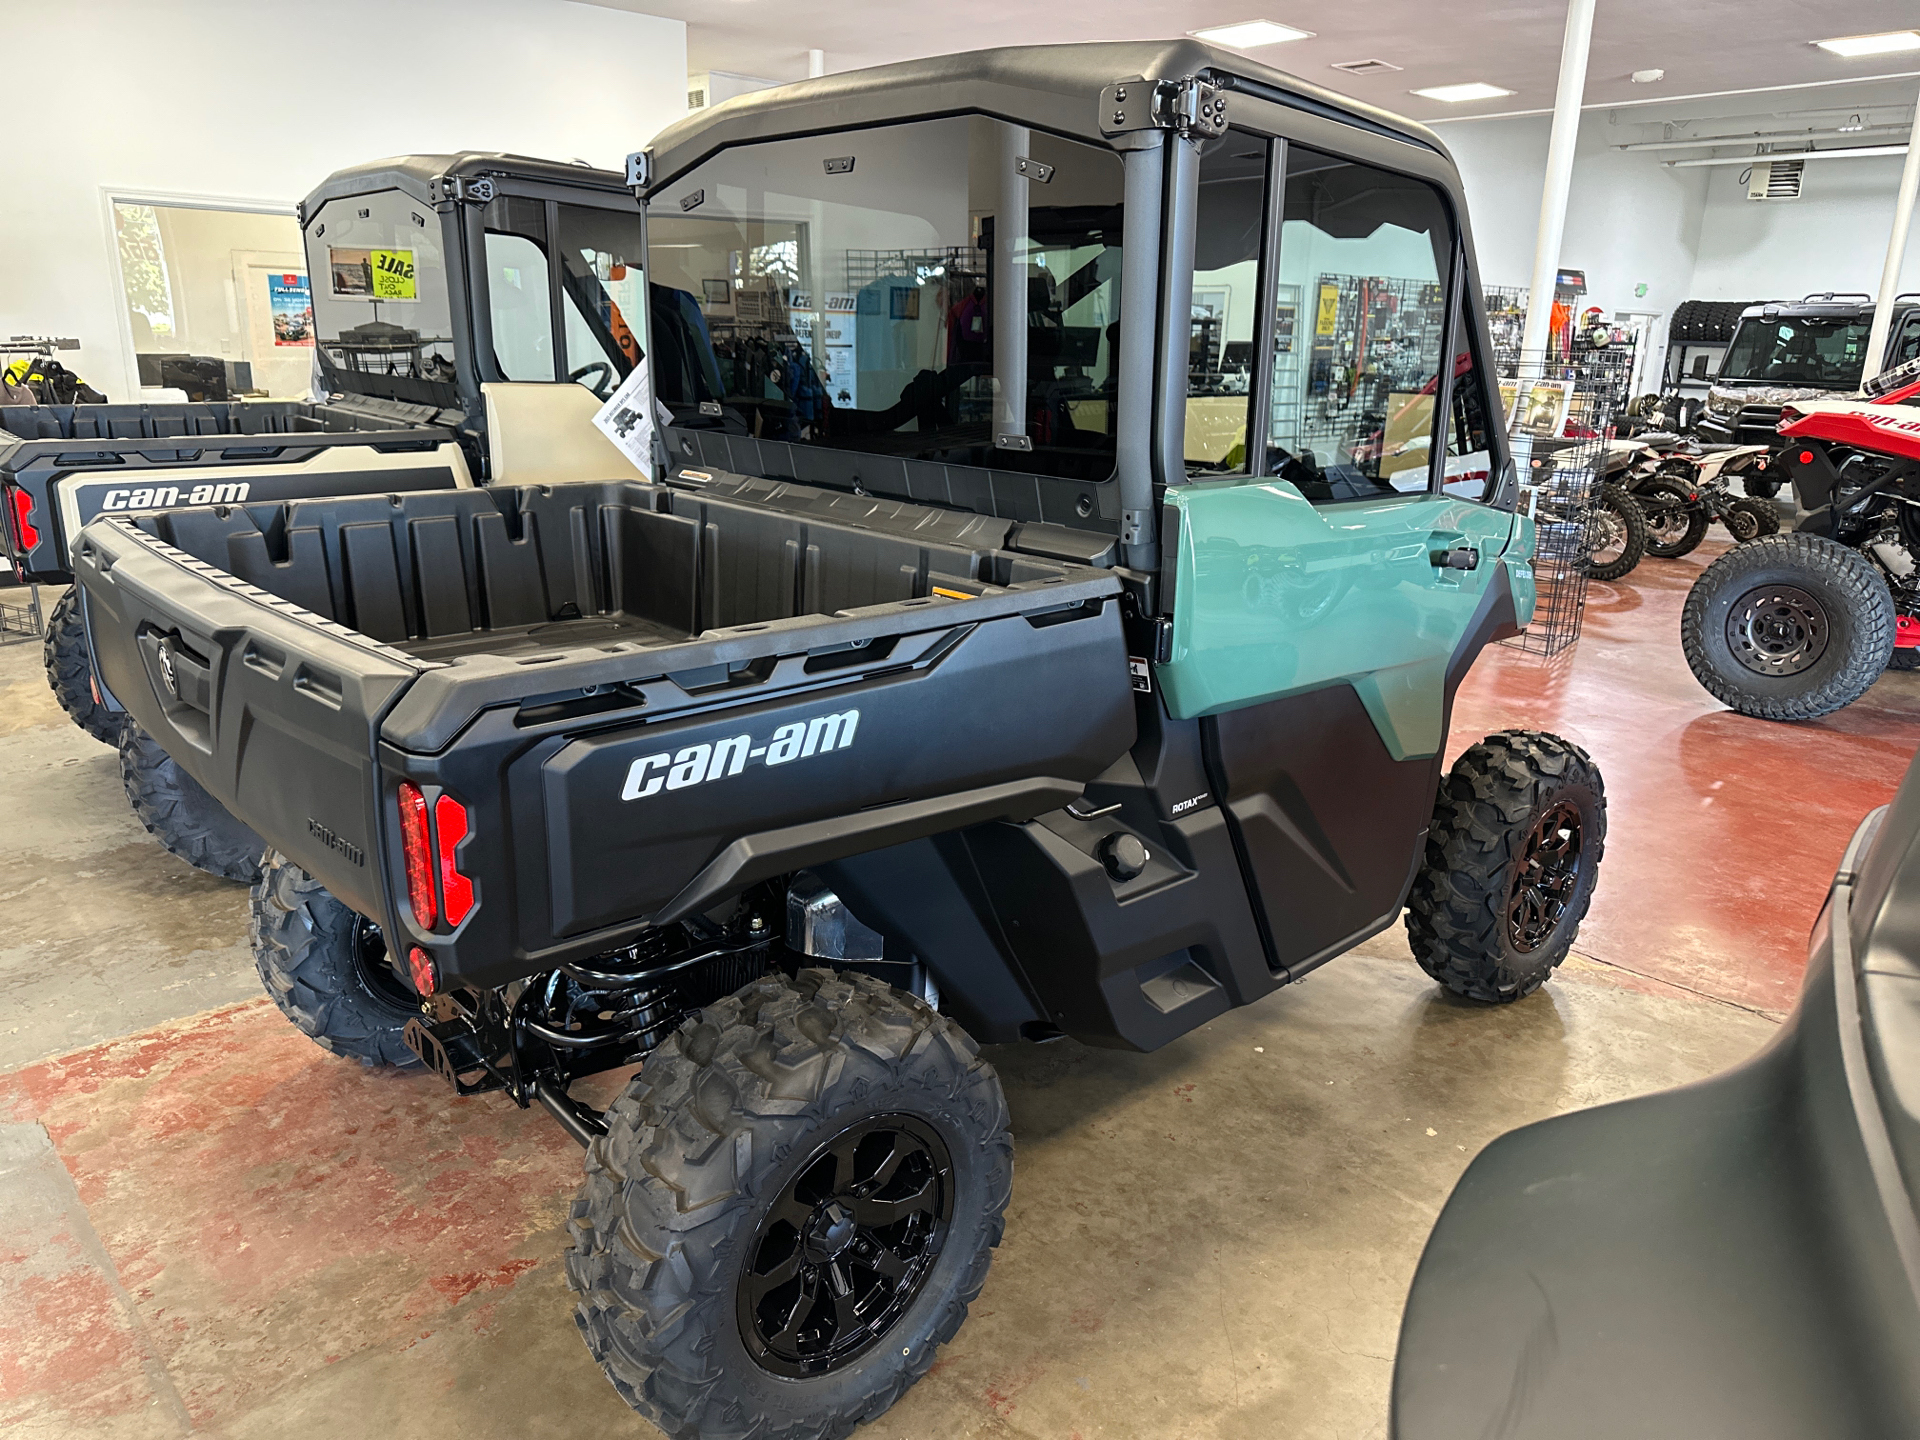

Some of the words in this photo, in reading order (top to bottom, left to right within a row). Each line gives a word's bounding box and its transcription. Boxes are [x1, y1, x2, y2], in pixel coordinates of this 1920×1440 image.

[792, 295, 855, 310] ca-am
[1534, 381, 1562, 390] can-am
[102, 482, 251, 511] can-am
[620, 708, 860, 801] can-am
[1172, 797, 1198, 814] ROTAX
[307, 817, 365, 868] can-am
